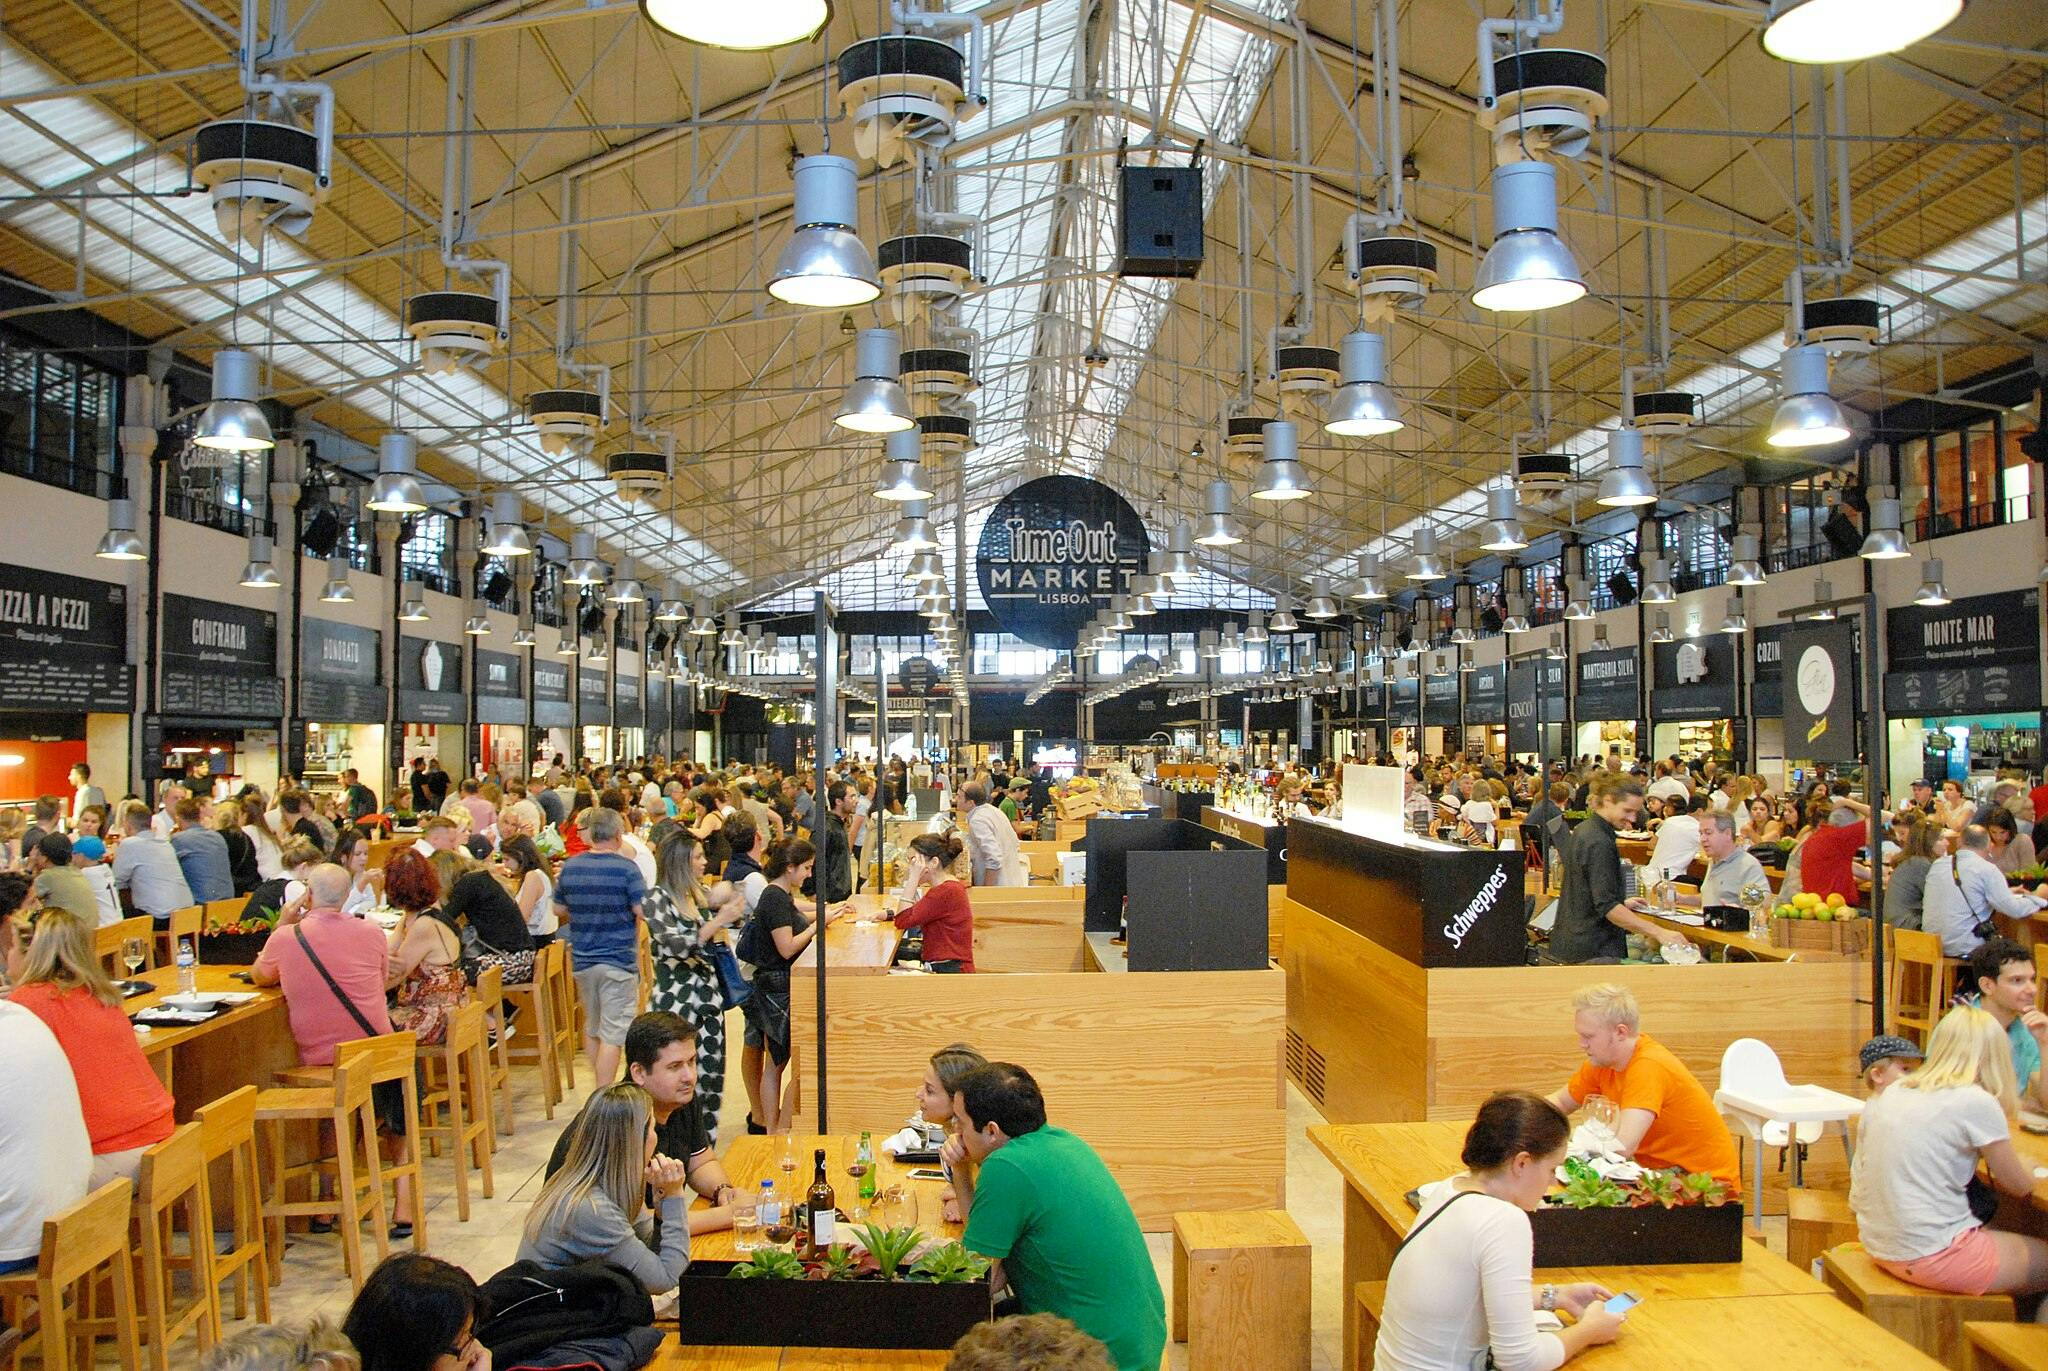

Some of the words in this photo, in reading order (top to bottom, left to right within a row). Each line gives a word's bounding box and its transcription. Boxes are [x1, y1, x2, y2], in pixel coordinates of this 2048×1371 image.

[1006, 518, 1067, 562] Time
[1069, 520, 1117, 563] Out
[991, 568, 1136, 589] MARKET
[37, 594, 47, 625] A
[52, 596, 90, 631] PEZZI
[1039, 593, 1090, 604] LISBOA
[192, 618, 246, 650] CONFRARIA
[1924, 618, 1963, 647] MONTE
[1967, 615, 1995, 642] MAR
[1617, 659, 1634, 677] SILVA
[1509, 701, 1533, 718] CINCO
[1443, 865, 1508, 949] Schweppes
